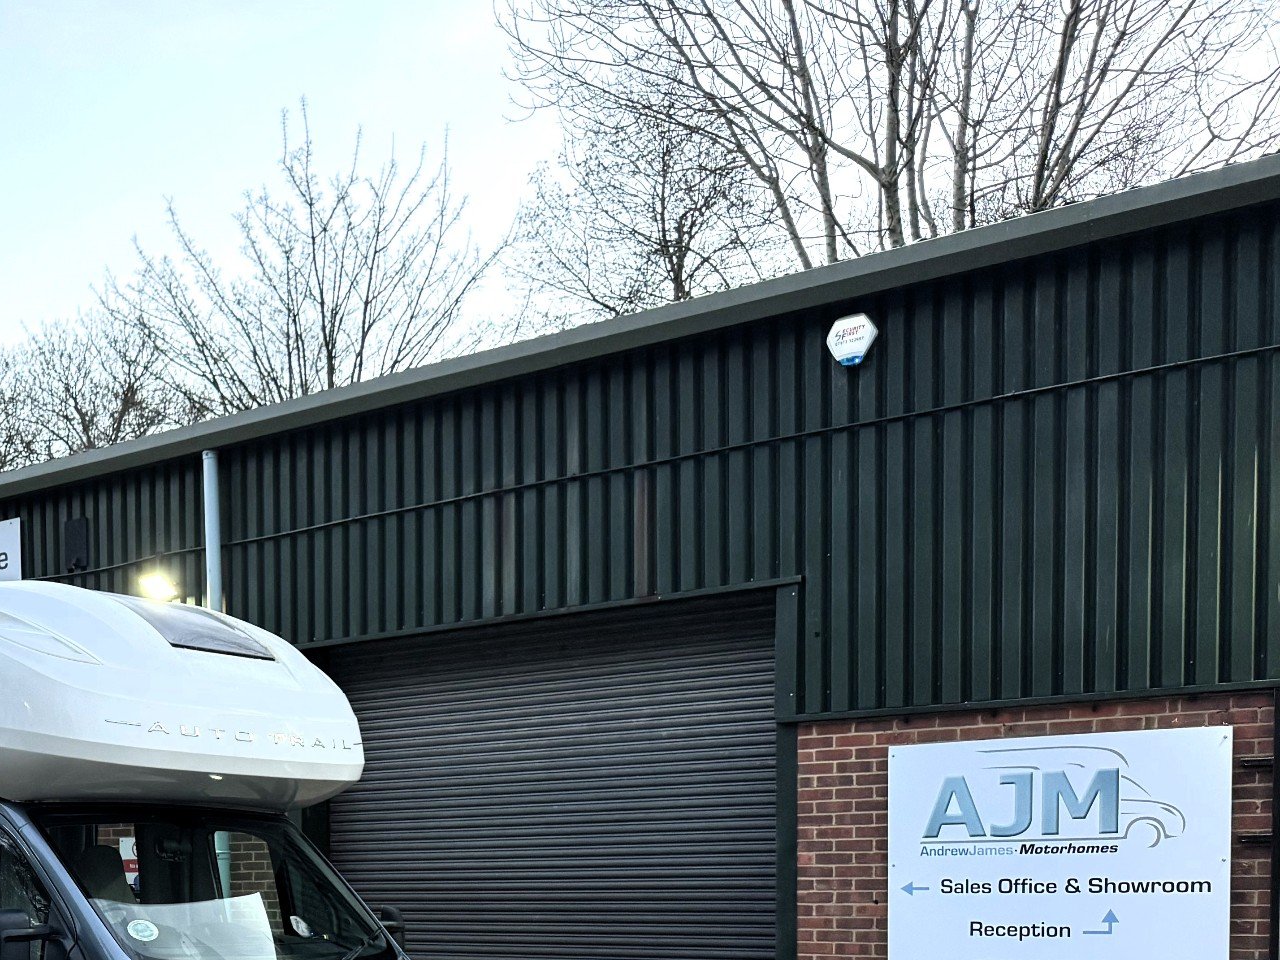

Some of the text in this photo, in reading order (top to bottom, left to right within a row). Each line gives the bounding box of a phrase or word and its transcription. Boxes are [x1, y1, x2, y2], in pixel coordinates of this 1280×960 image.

[148, 721, 351, 750] AUTO TRAIL
[922, 768, 1120, 838] AJM
[940, 878, 1212, 894] Sales Office & Showroom
[970, 921, 1071, 941] Reception
